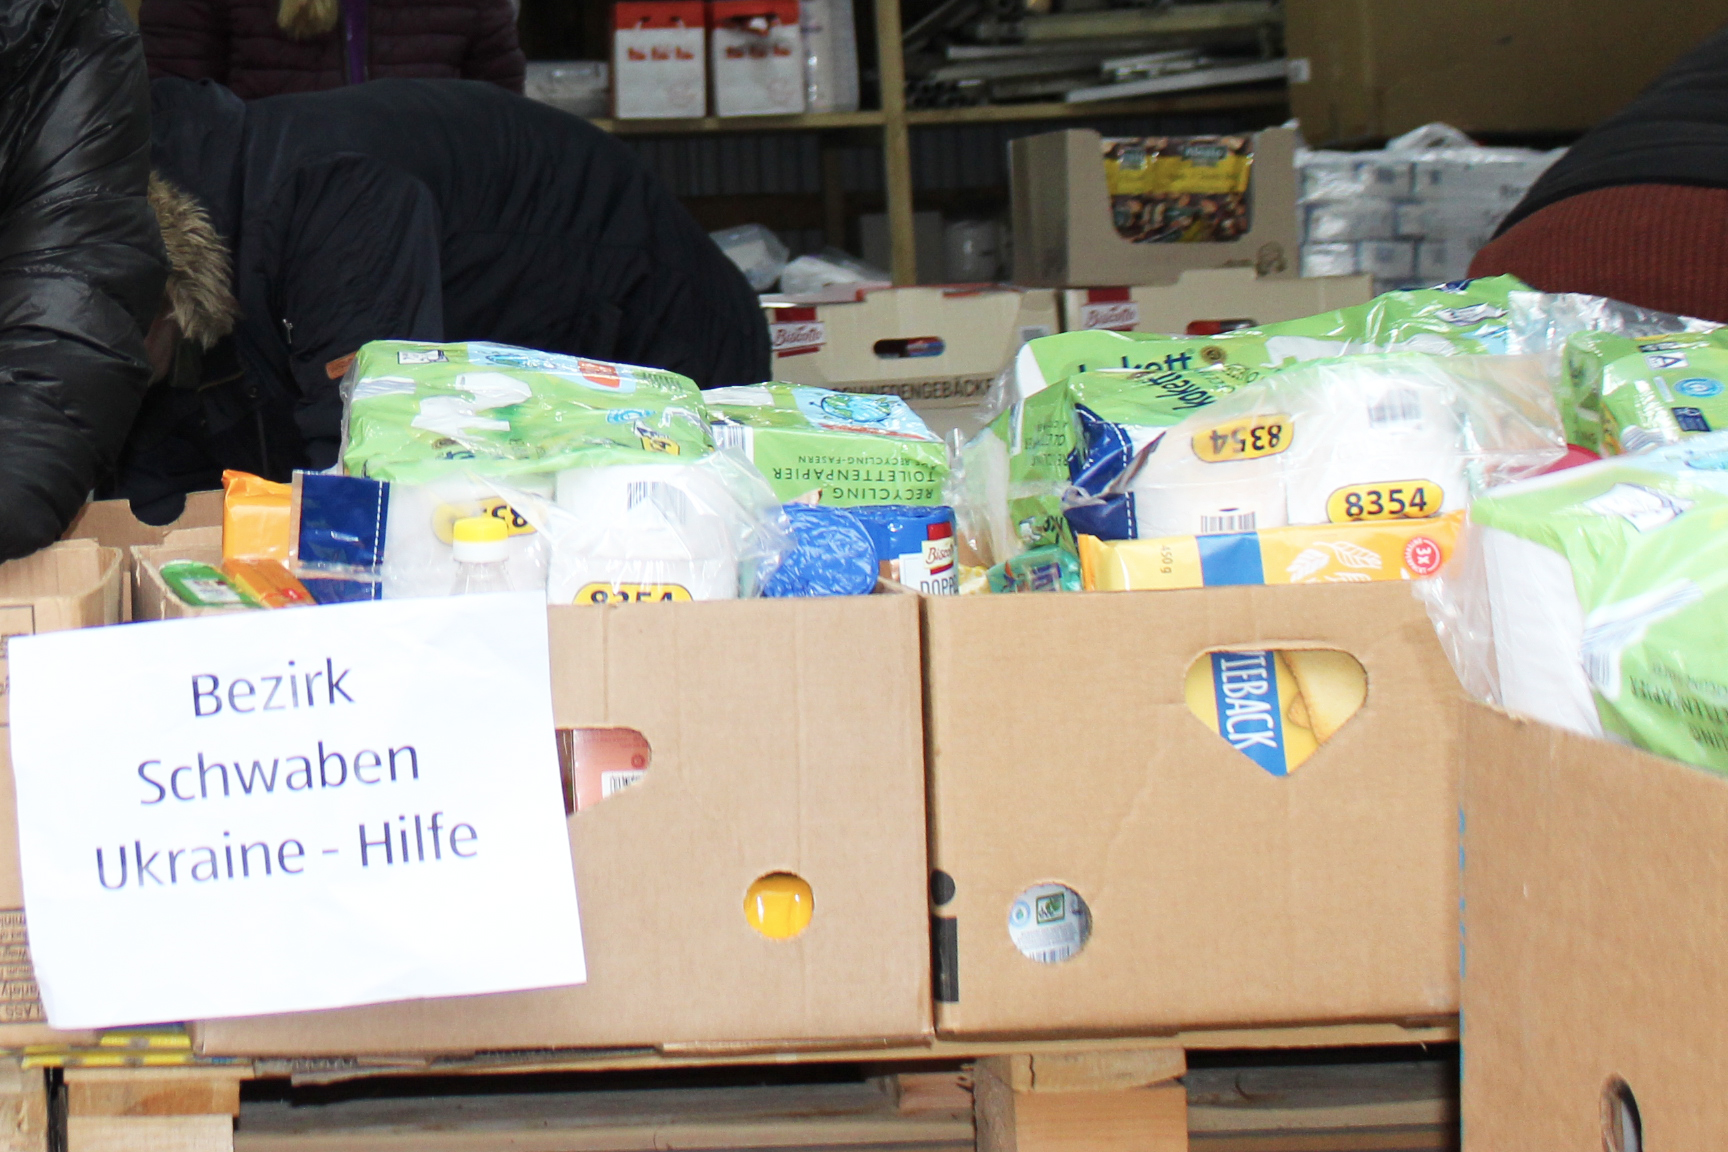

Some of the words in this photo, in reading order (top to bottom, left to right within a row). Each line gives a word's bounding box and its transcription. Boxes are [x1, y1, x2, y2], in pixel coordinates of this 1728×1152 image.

[1209, 423, 1283, 449] 8354
[773, 467, 936, 482] TOILETTENPAPIER
[832, 487, 933, 500] RECYCLING
[1344, 487, 1428, 517] 8354
[191, 657, 355, 717] Bezirk
[136, 741, 419, 804] Schwaben
[95, 831, 305, 890] Ukraine
[359, 812, 479, 867] Hilfe
